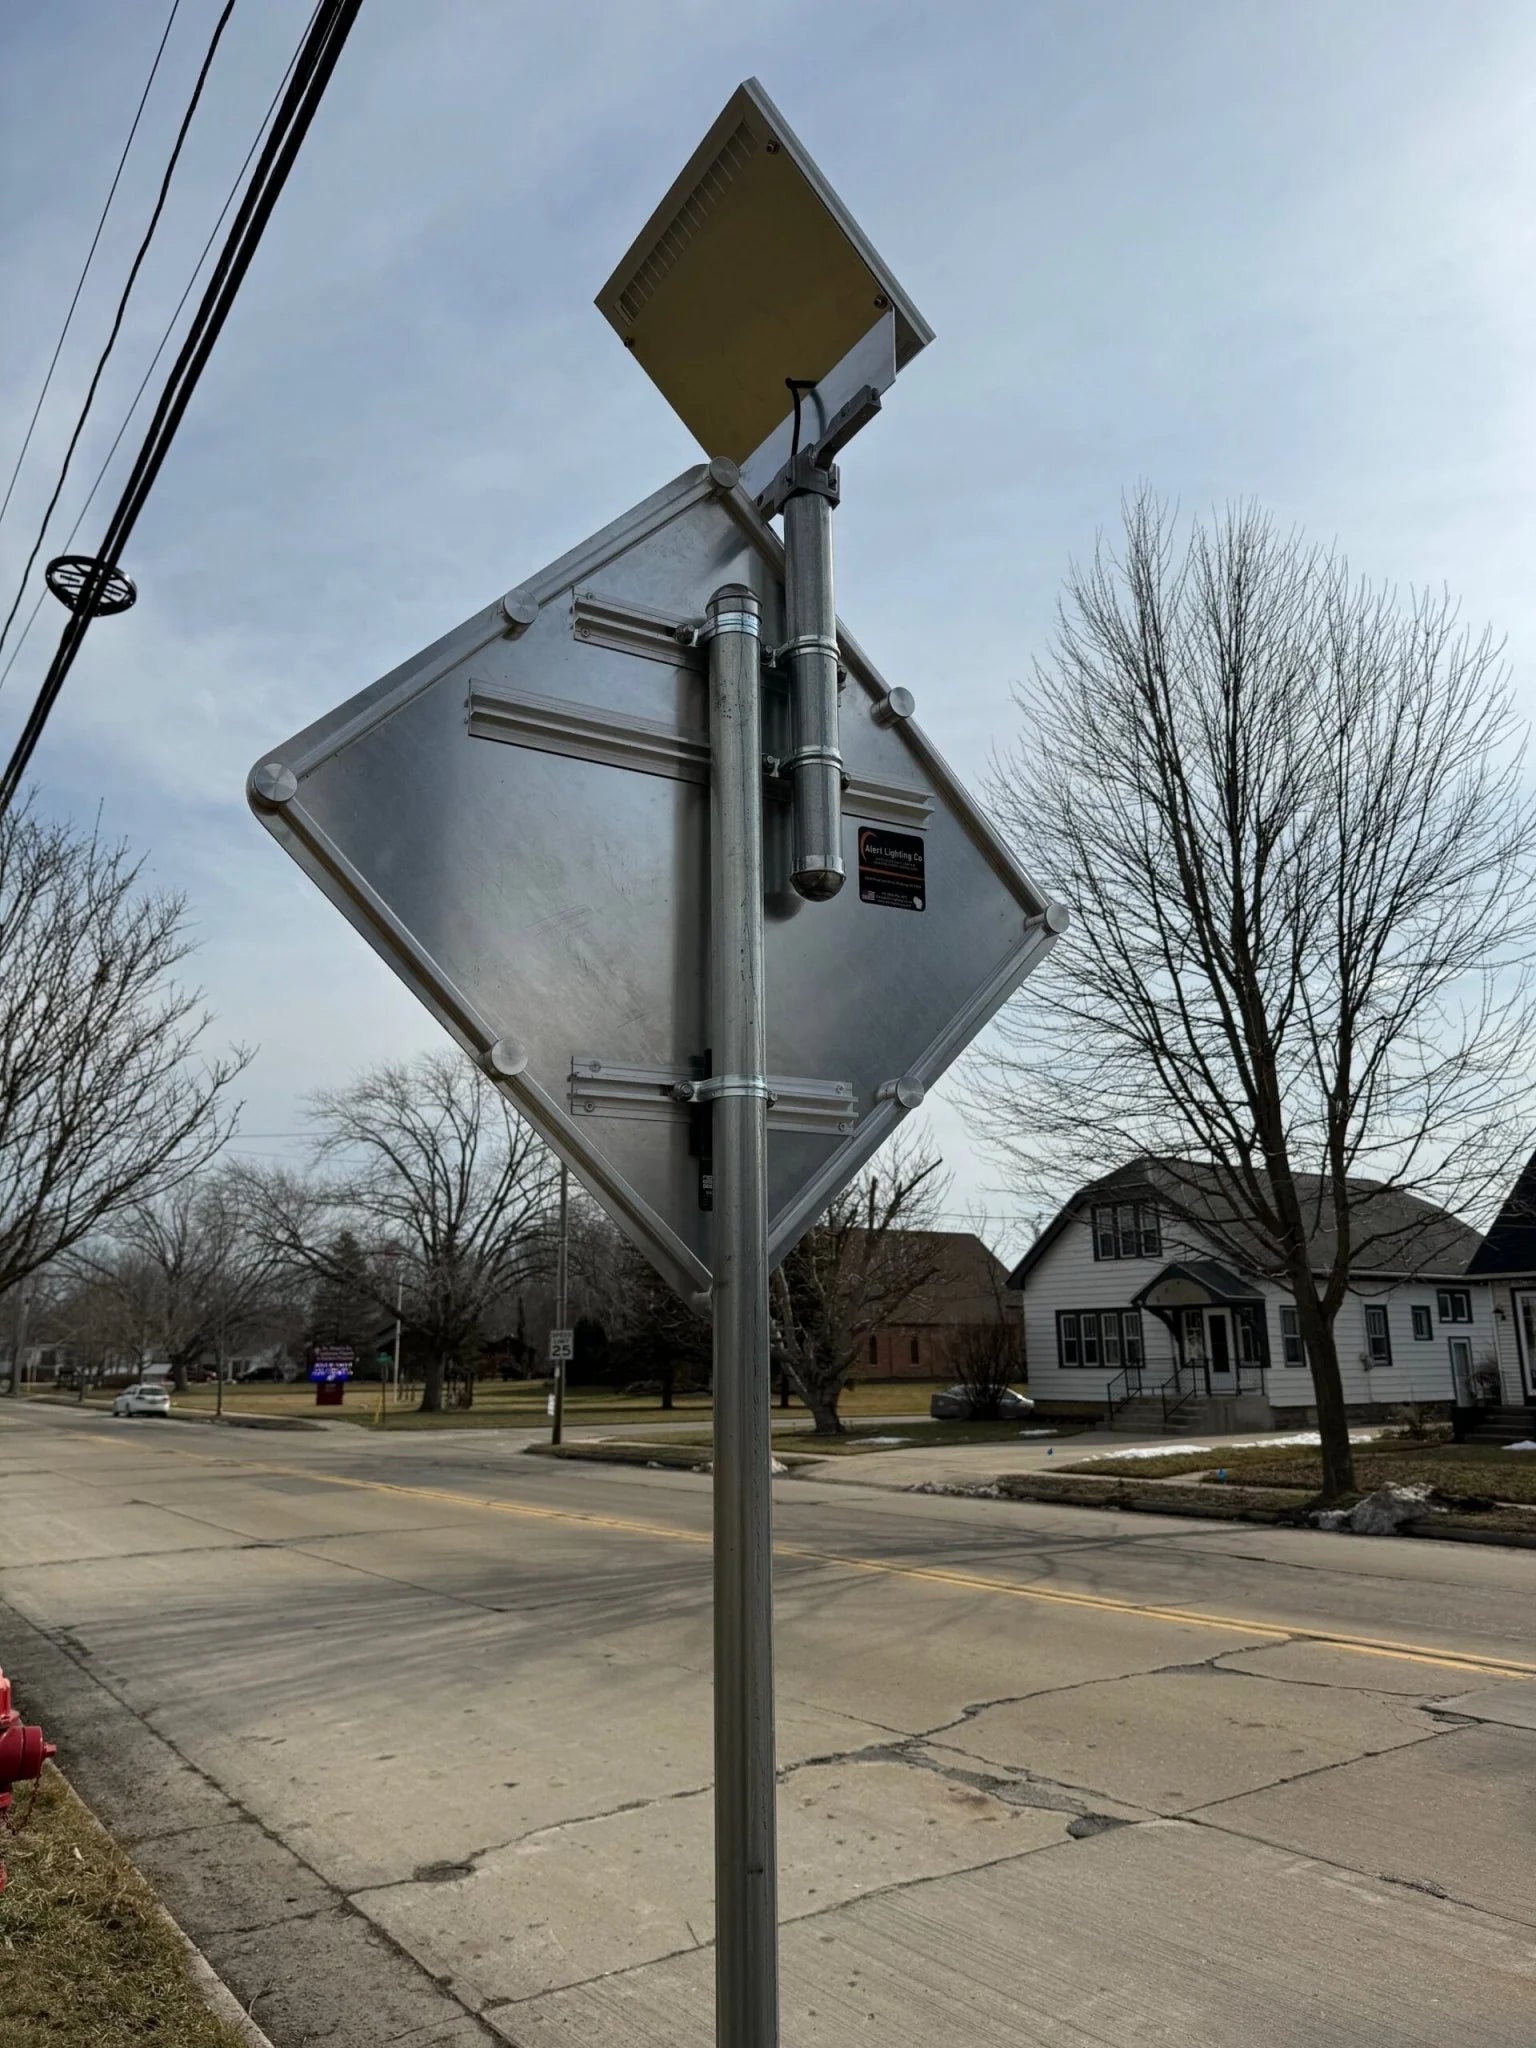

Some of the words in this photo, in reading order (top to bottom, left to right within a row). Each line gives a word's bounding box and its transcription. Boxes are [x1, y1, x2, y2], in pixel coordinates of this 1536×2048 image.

[865, 844, 883, 855] Alert
[884, 847, 911, 862] Lighting
[552, 1344, 571, 1357] 25
